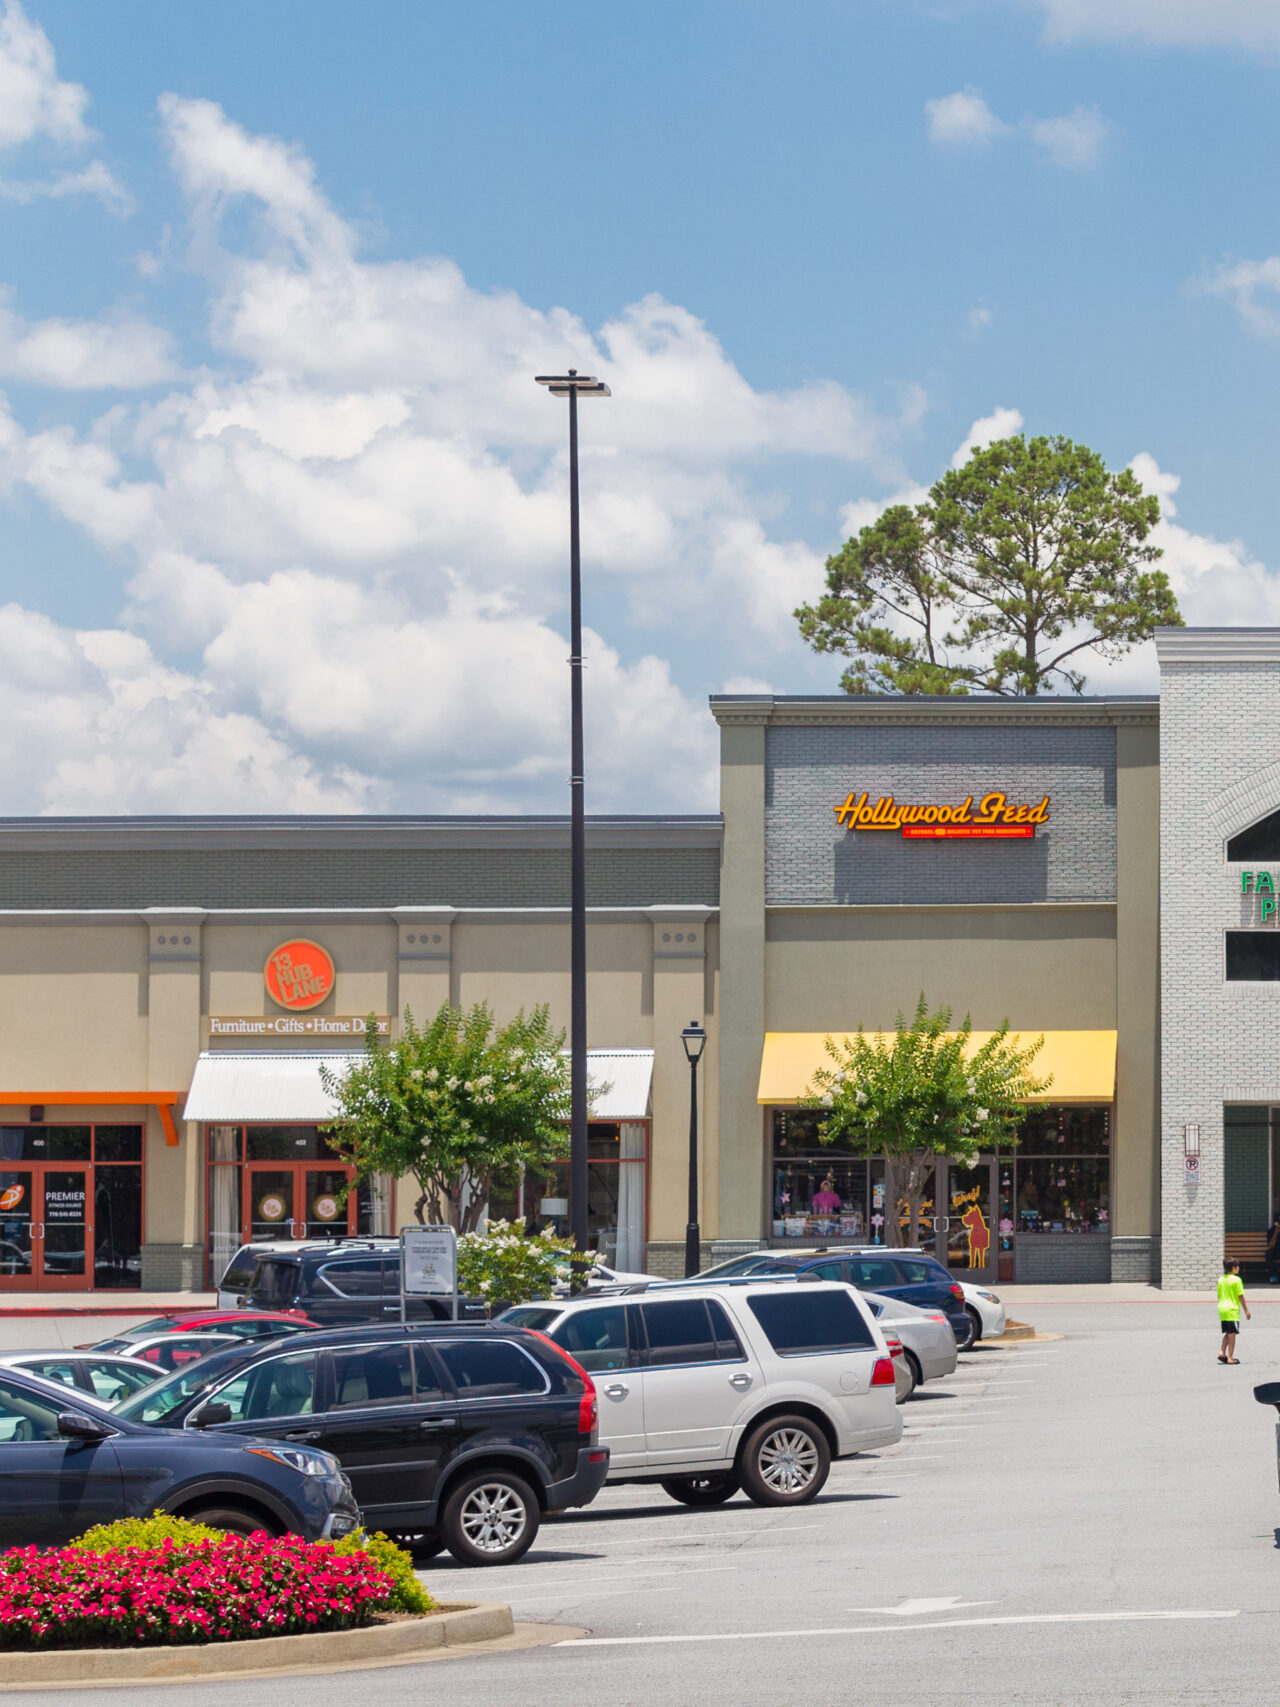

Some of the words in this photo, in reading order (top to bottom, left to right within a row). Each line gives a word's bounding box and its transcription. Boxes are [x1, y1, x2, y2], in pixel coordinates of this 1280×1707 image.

[833, 792, 973, 829] Hollywood
[973, 792, 1050, 824] Feed
[272, 953, 292, 972] 13
[275, 964, 312, 988] HUB
[279, 976, 328, 1003] LANE
[210, 1018, 266, 1033] Furniture
[274, 1018, 305, 1033] Gifts
[313, 1018, 350, 1033] Home
[352, 1018, 388, 1033] Deor
[46, 1192, 85, 1200] PREMIER
